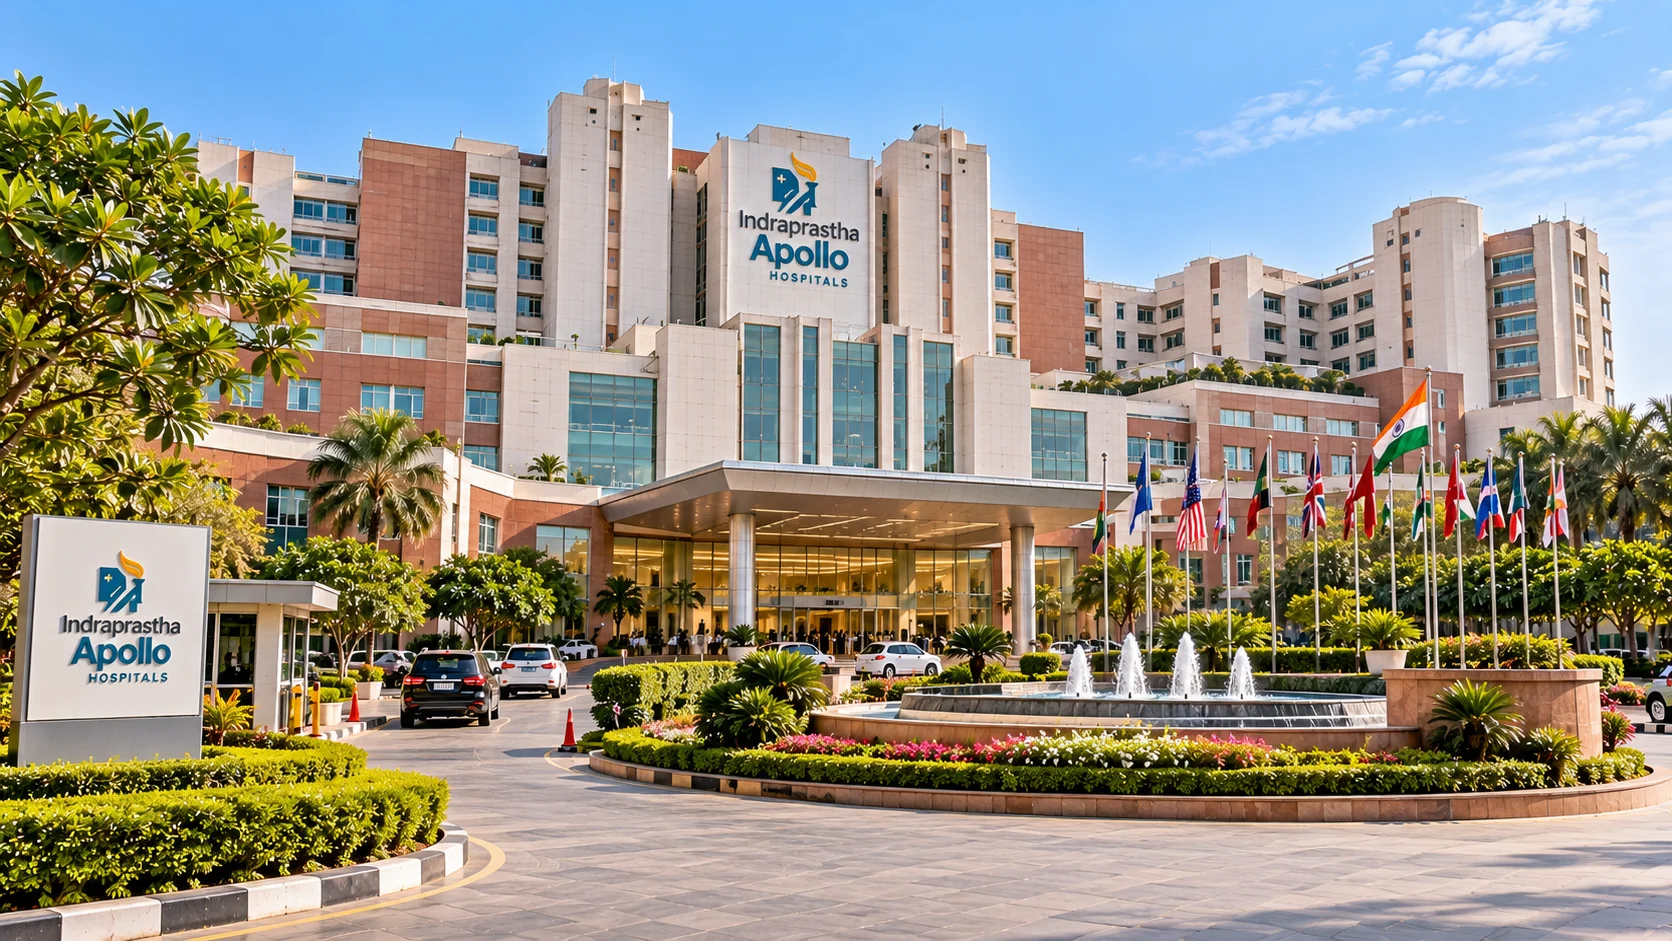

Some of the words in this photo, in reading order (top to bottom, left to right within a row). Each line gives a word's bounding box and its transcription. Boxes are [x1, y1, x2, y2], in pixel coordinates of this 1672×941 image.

[739, 209, 860, 242] Indraprastha
[749, 233, 849, 271] Apollo
[769, 271, 848, 288] HOSPITALS
[61, 615, 181, 637] Indraprastha
[69, 636, 172, 672] Apollo
[87, 672, 168, 684] HOSPITALS
